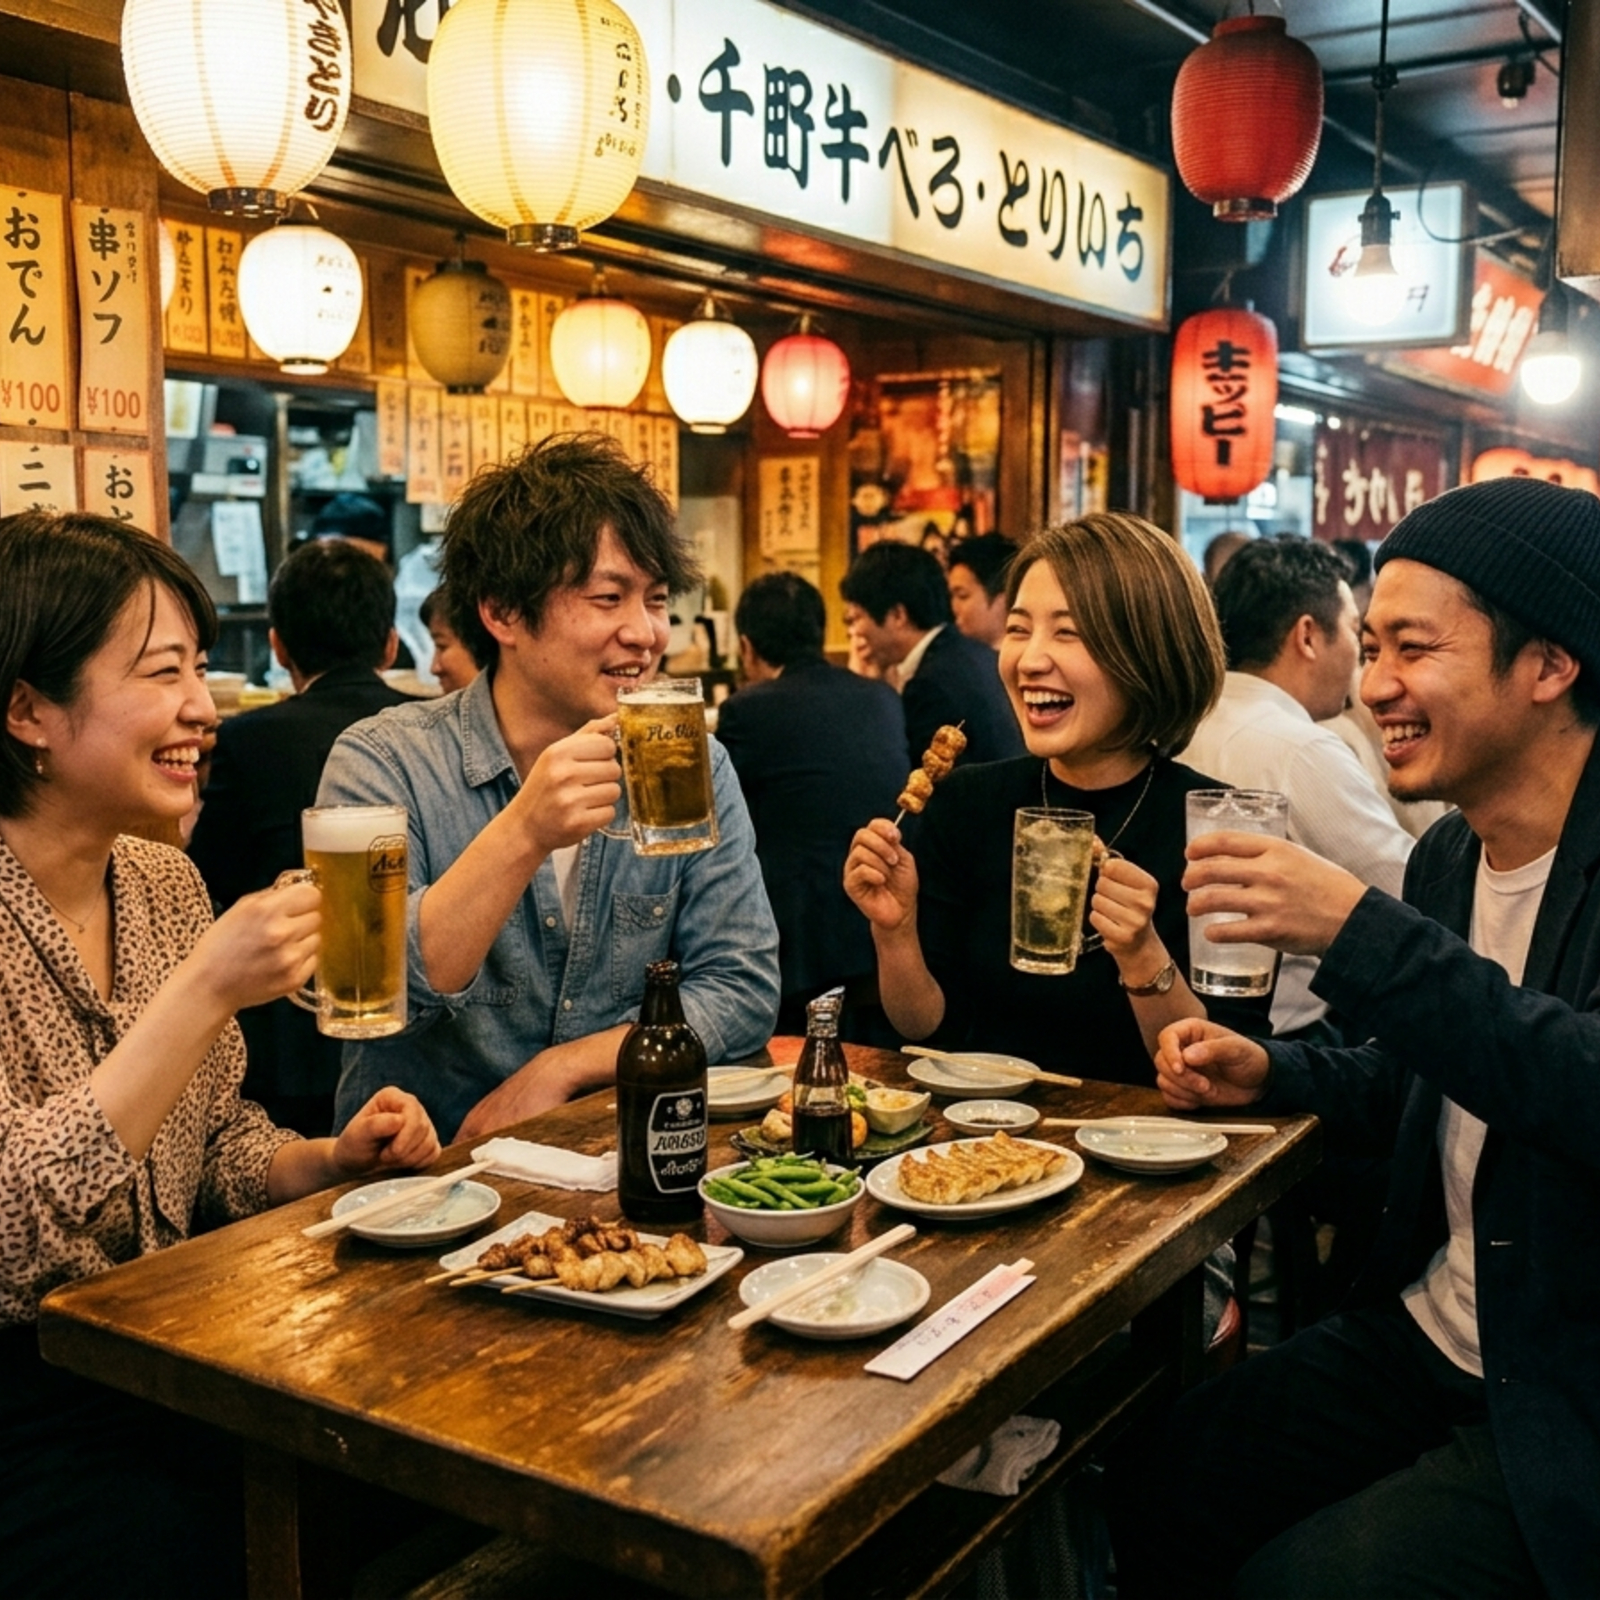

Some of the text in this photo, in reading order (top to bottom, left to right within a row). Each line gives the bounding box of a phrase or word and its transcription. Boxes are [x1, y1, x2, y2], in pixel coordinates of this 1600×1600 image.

[4, 206, 46, 346] おでん
[88, 217, 122, 344] 串ソフ
[1, 379, 61, 413] ¥100
[86, 386, 141, 419] ¥100
